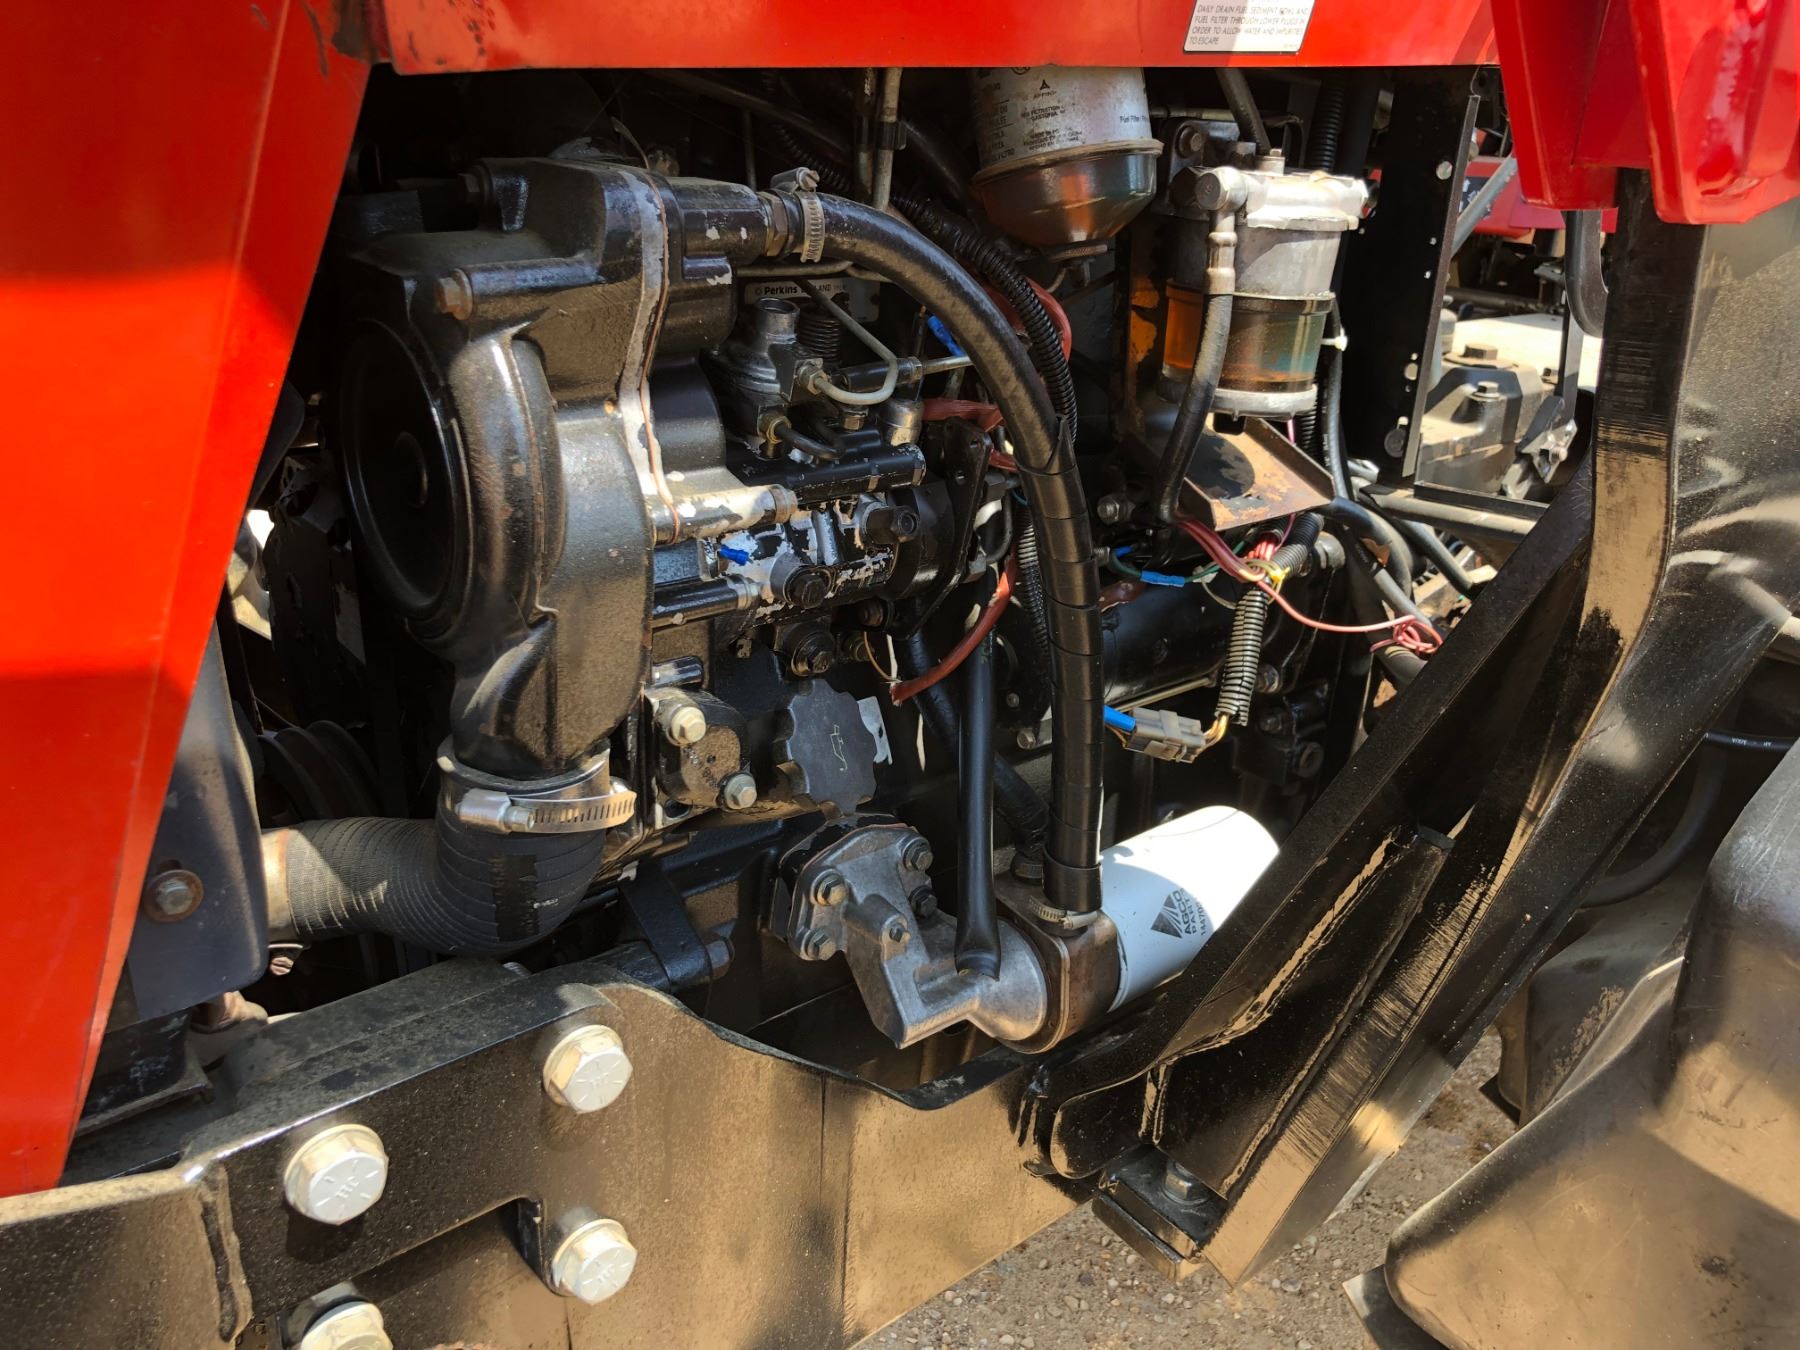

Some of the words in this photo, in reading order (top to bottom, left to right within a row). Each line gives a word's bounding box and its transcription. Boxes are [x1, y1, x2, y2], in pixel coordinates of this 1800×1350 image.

[1197, 5, 1214, 13] DAILY
[1215, 5, 1234, 13] DRAIN
[1235, 5, 1248, 14] FUEL
[1194, 15, 1208, 24] FUEL
[1211, 15, 1229, 24] FILTER
[1231, 16, 1259, 25] THROUGH
[1192, 26, 1211, 34] ORDER
[1213, 26, 1222, 34] TO
[1222, 27, 1242, 35] ALLOW
[1198, 36, 1220, 45] ESCAPE
[764, 286, 798, 295] Perkins
[1172, 890, 1192, 935] AGCO
